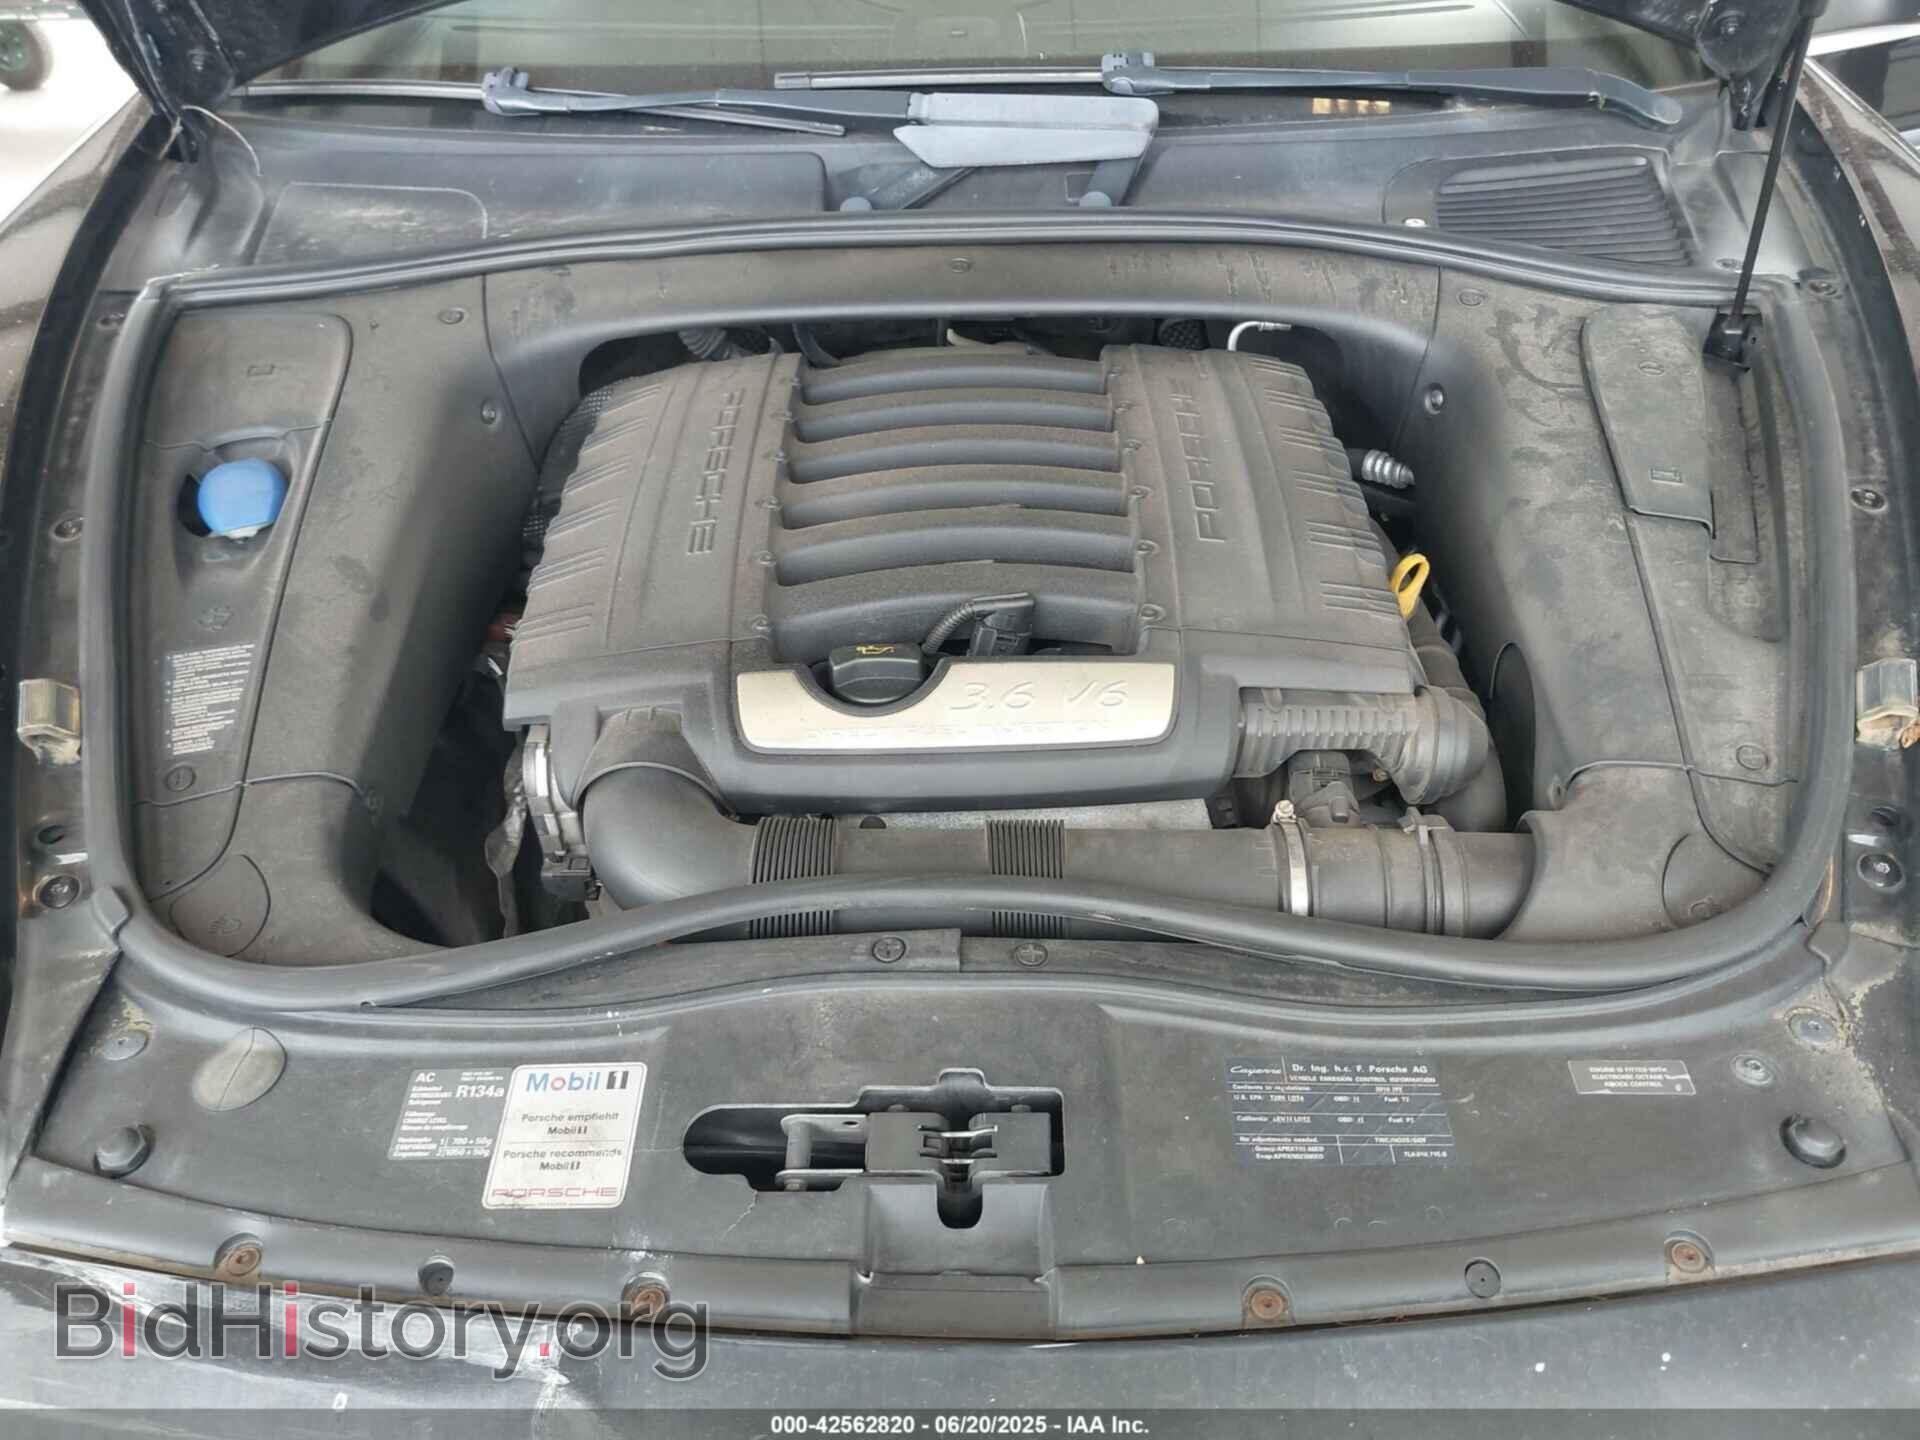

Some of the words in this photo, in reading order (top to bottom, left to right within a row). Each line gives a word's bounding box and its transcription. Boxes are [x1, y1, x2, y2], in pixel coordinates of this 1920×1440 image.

[686, 386, 746, 556] PORSCHE
[949, 681, 1034, 711] 3.6
[1230, 1065, 1281, 1077] Cayenne
[1292, 1064, 1306, 1072] Dr.
[1310, 1064, 1329, 1074] Ing.
[1369, 1065, 1408, 1073] Porsche
[1413, 1065, 1428, 1073] AG
[416, 1072, 436, 1082] AC
[525, 1072, 600, 1092] Mobil
[606, 1070, 629, 1090] 1
[456, 1085, 504, 1098] R134a
[521, 1113, 564, 1122] Porsche
[548, 1126, 577, 1135] Mobil
[503, 1149, 546, 1159] Porsche
[550, 1148, 622, 1158] recommends
[539, 1161, 569, 1170] Mobil
[492, 1187, 617, 1199] PORSCHE
